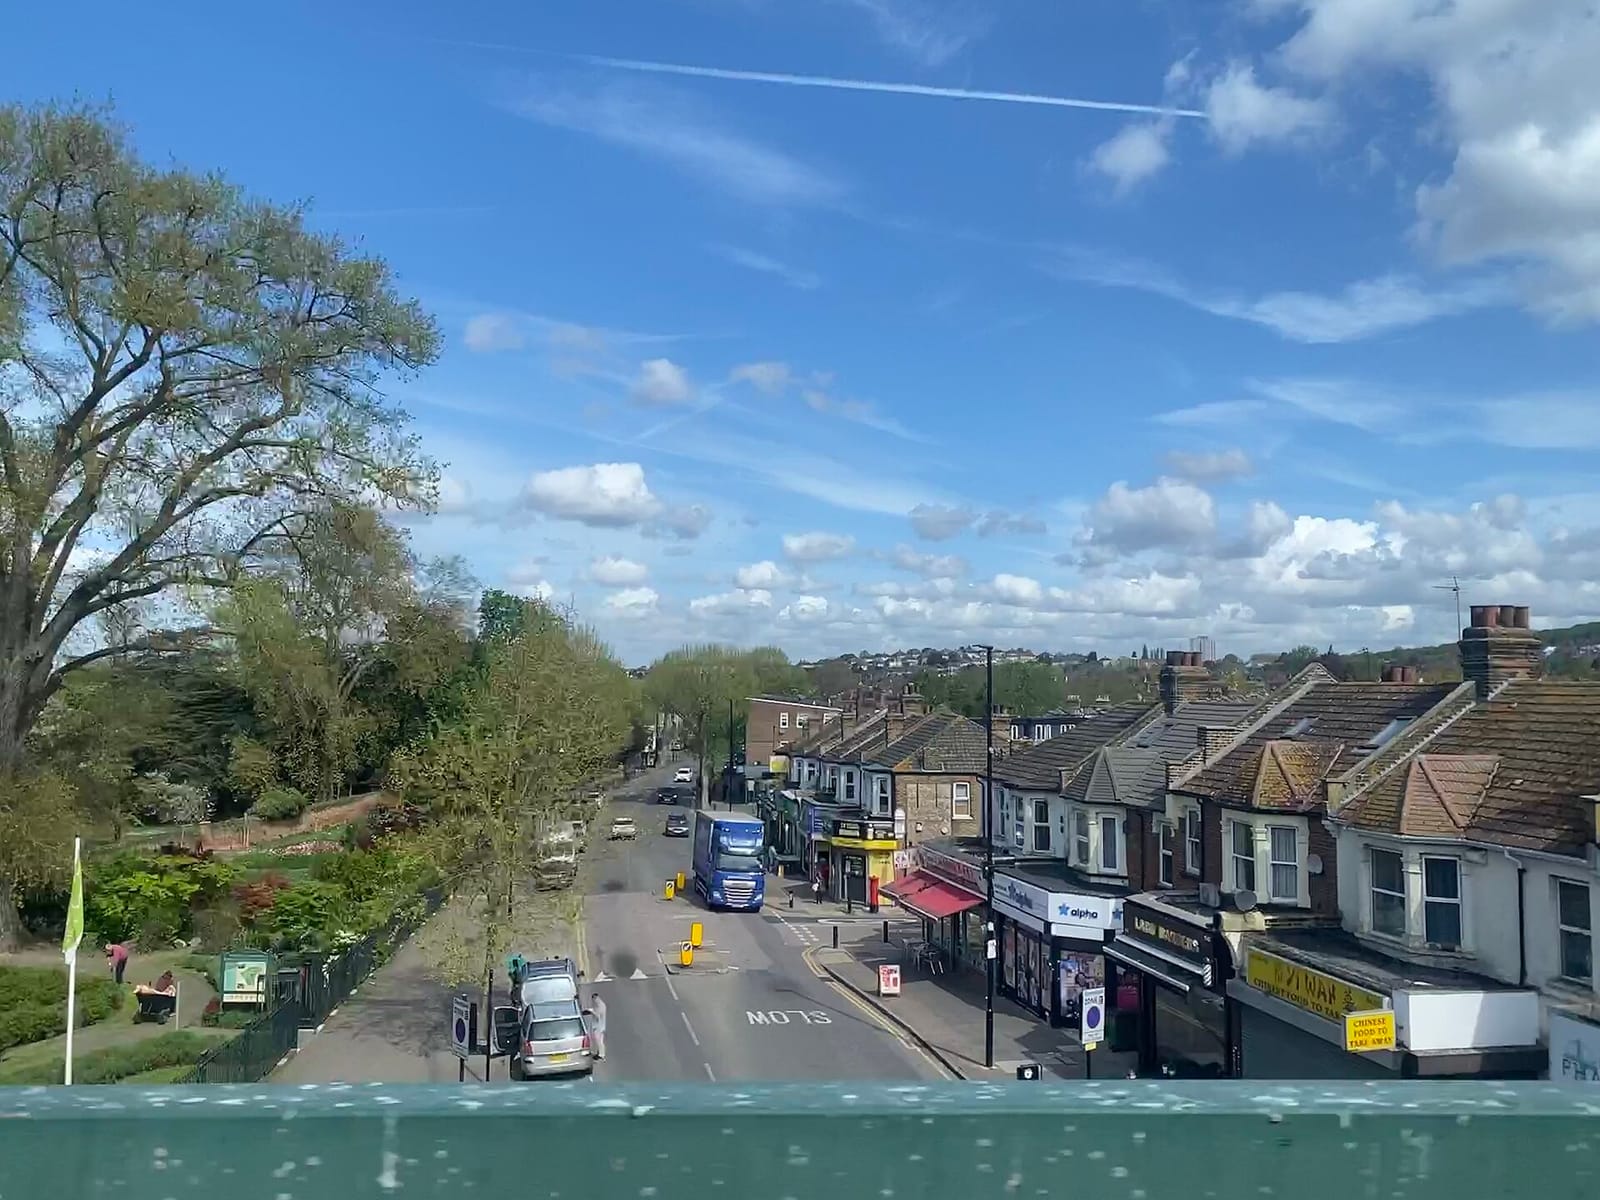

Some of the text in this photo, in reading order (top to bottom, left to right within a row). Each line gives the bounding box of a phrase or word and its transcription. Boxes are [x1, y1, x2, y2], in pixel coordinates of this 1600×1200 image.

[1070, 907, 1098, 919] alpha
[1254, 977, 1284, 998] CHINE
[1304, 972, 1336, 1005] WAN
[745, 1010, 832, 1025] SLOW
[1353, 1018, 1386, 1028] CHINESE
[1353, 1027, 1388, 1038] FOOD TO
